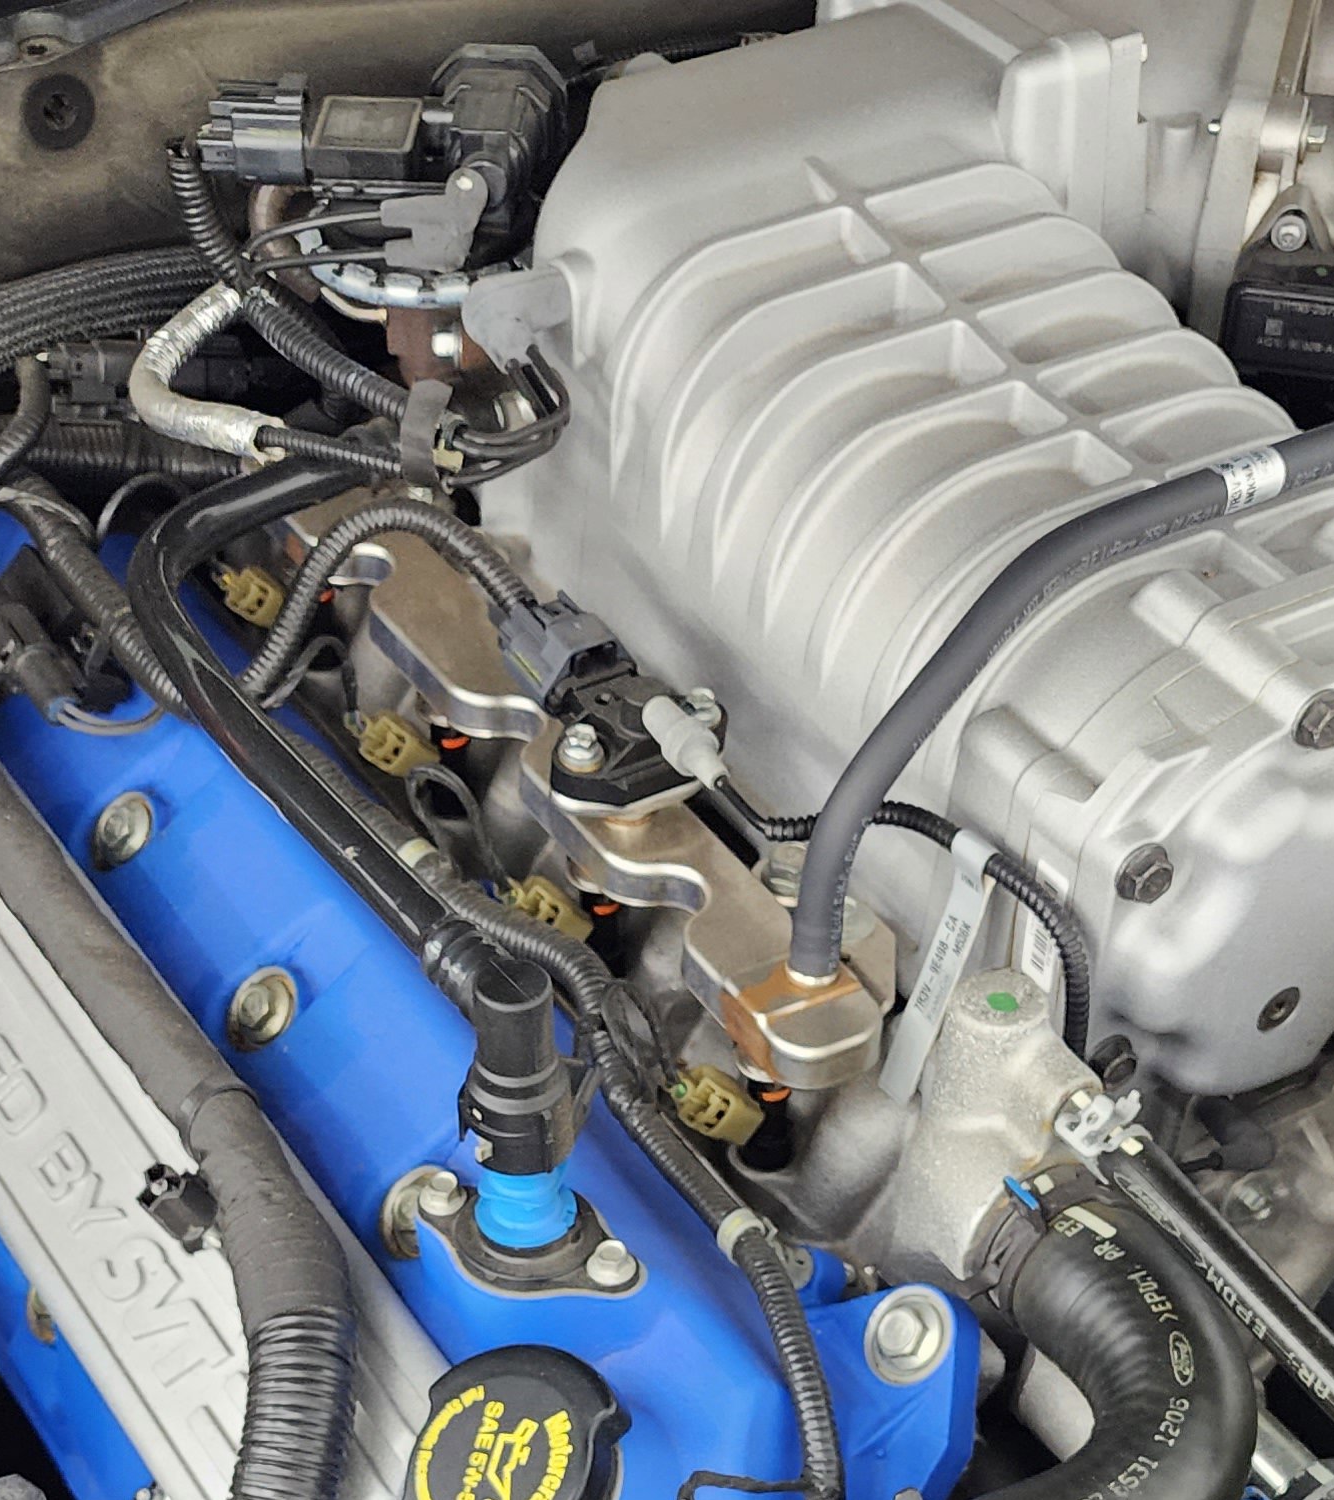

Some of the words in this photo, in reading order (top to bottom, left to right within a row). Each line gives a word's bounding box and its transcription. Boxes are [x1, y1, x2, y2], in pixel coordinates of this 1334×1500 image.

[29, 1129, 129, 1237] BY
[90, 1235, 236, 1390] SVT
[473, 1400, 506, 1451] SAE
